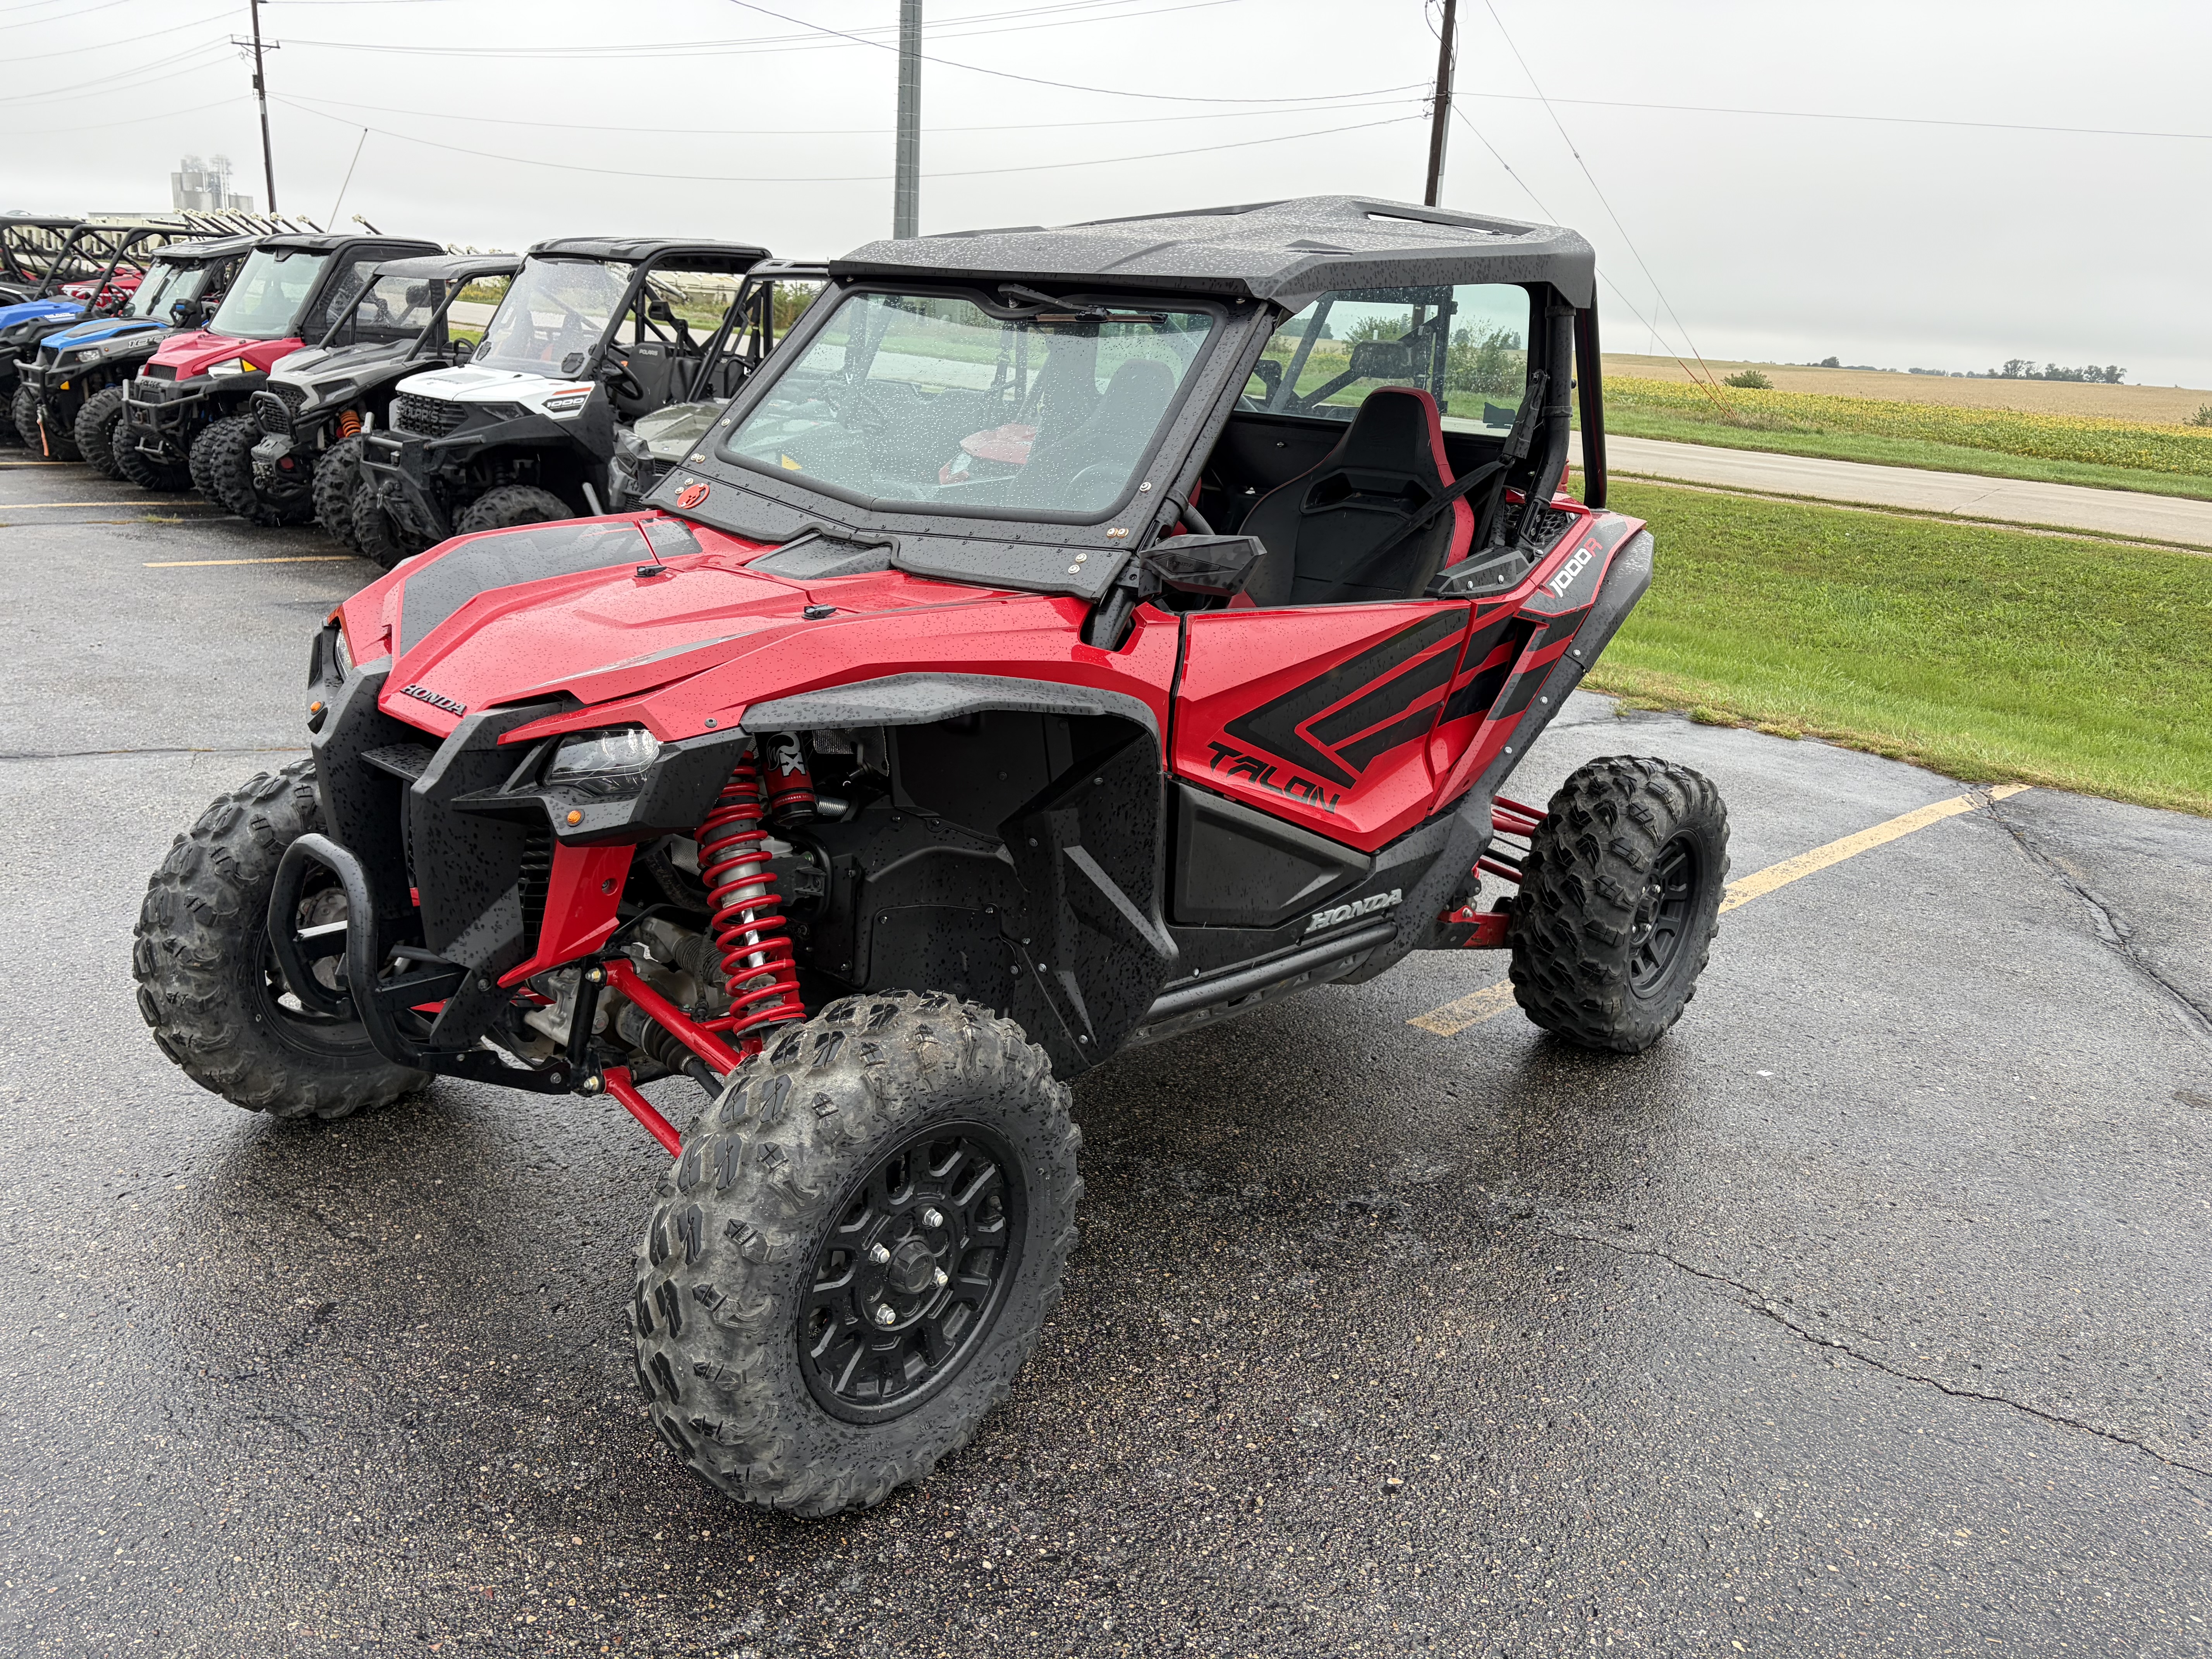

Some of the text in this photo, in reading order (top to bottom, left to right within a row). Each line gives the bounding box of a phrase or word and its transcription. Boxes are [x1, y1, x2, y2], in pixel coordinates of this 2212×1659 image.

[397, 405, 439, 423] POLARIS
[547, 397, 584, 408] 1000
[1549, 538, 1603, 598] 1000R
[399, 684, 467, 718] HONDA
[1207, 740, 1341, 815] TALON
[1304, 888, 1403, 934] HONDA
